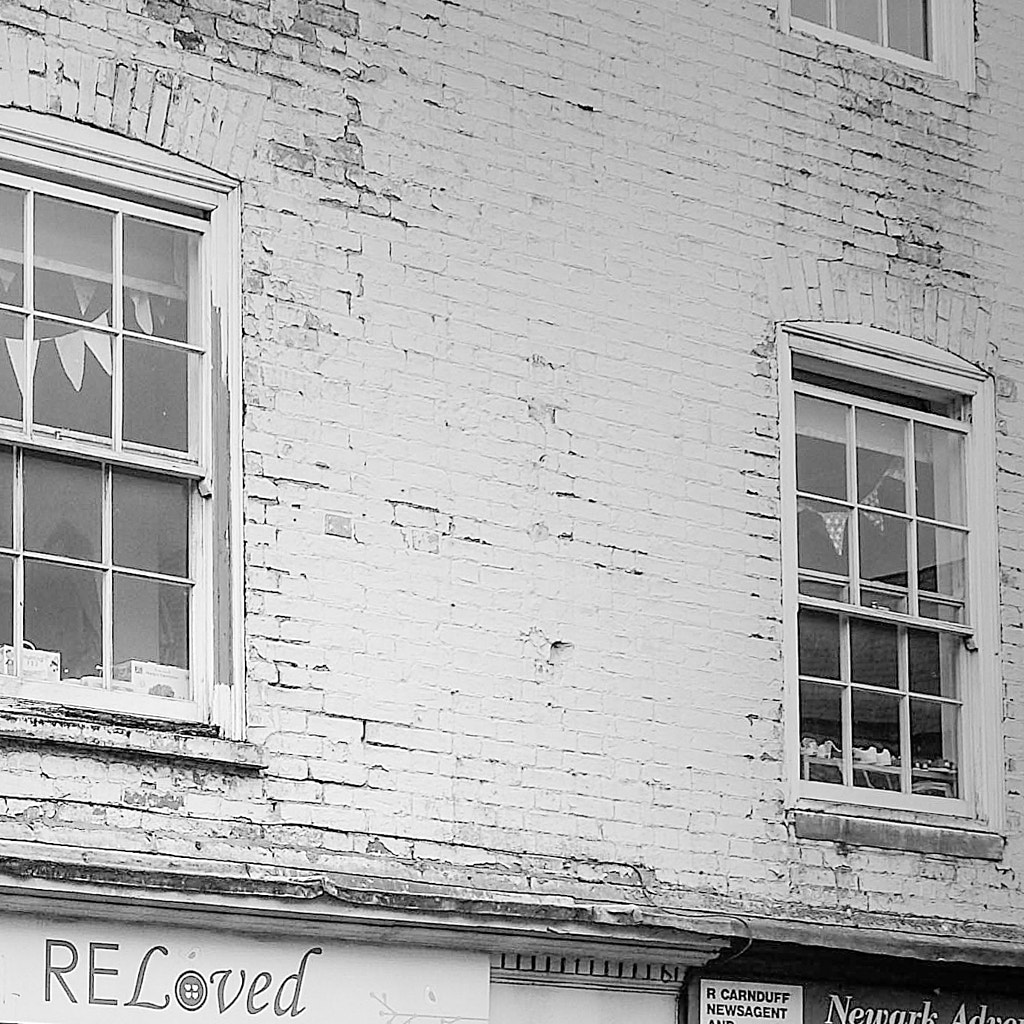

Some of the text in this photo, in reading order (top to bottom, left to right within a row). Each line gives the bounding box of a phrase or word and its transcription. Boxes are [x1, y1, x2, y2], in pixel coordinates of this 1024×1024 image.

[706, 987, 791, 1004] R CARNDUFF
[706, 1004, 788, 1020] NEWSAGENT
